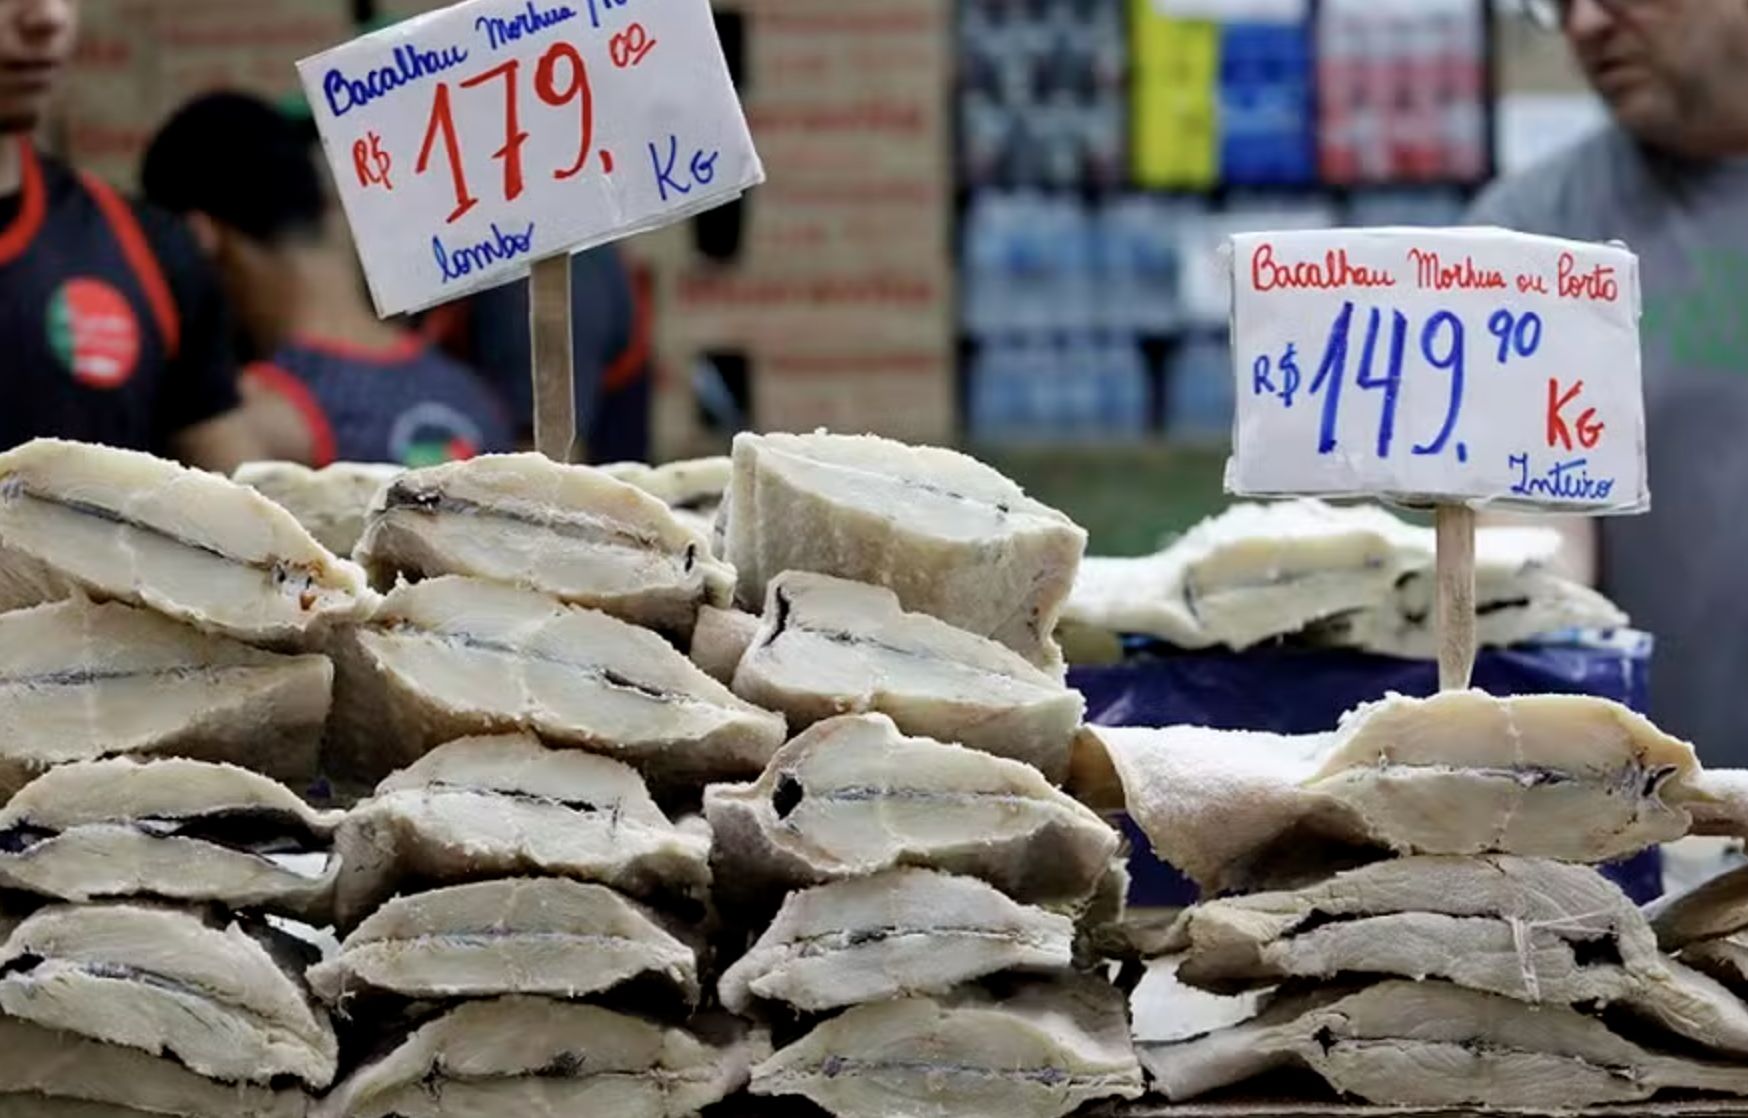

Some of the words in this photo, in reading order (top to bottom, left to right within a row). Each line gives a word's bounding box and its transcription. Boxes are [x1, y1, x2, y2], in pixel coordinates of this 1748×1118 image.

[323, 44, 468, 117] Bacalhau
[475, 2, 577, 49] Morhua
[352, 132, 393, 190] R$
[1252, 243, 1396, 292] Bacalhau
[1407, 248, 1507, 291] Morhua
[1516, 274, 1548, 294] ou
[1558, 252, 1618, 301] Porto
[1253, 343, 1300, 408] R$
[1488, 308, 1542, 364] 90
[1508, 453, 1615, 499] Inteiro
